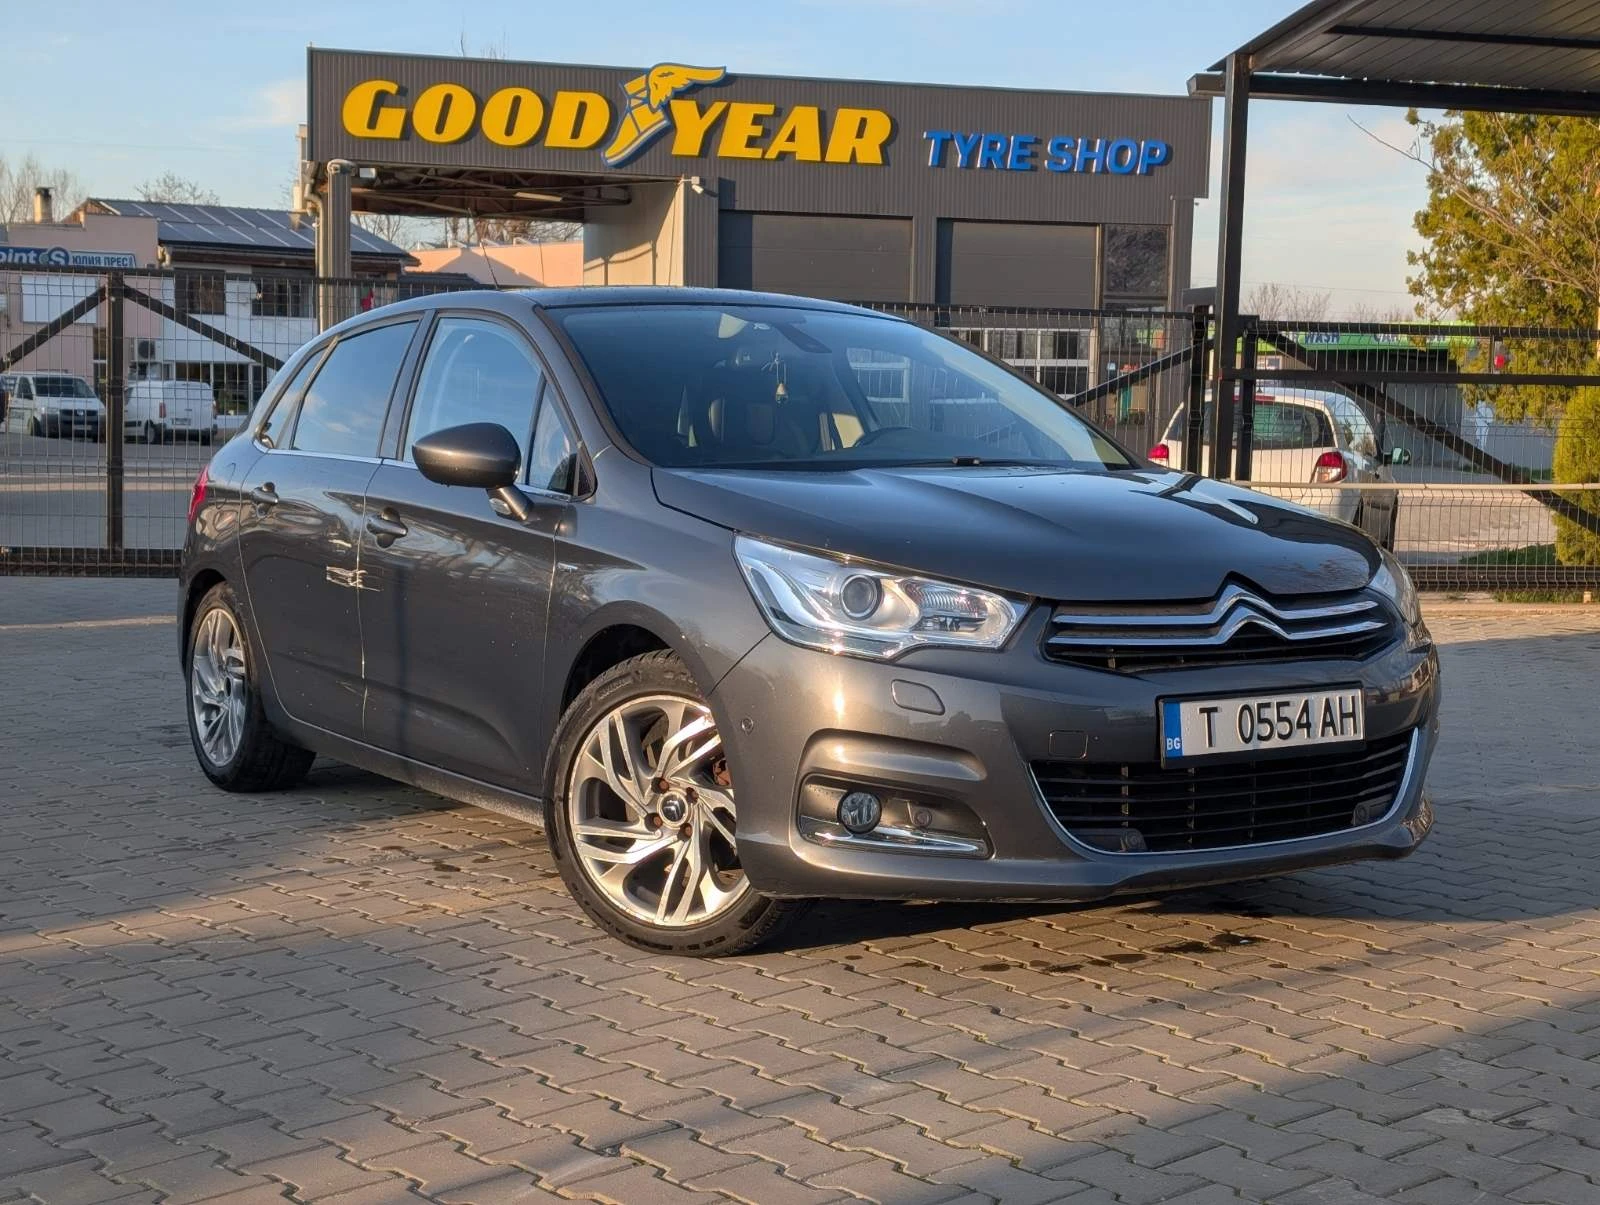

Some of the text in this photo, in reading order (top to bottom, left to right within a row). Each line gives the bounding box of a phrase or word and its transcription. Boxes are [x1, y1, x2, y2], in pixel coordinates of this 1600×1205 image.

[923, 131, 1168, 175] TYRE SHOP
[72, 255, 102, 266] ЮЛИЯ
[1199, 695, 1358, 748] T 0554 AH
[1166, 738, 1182, 750] BG
